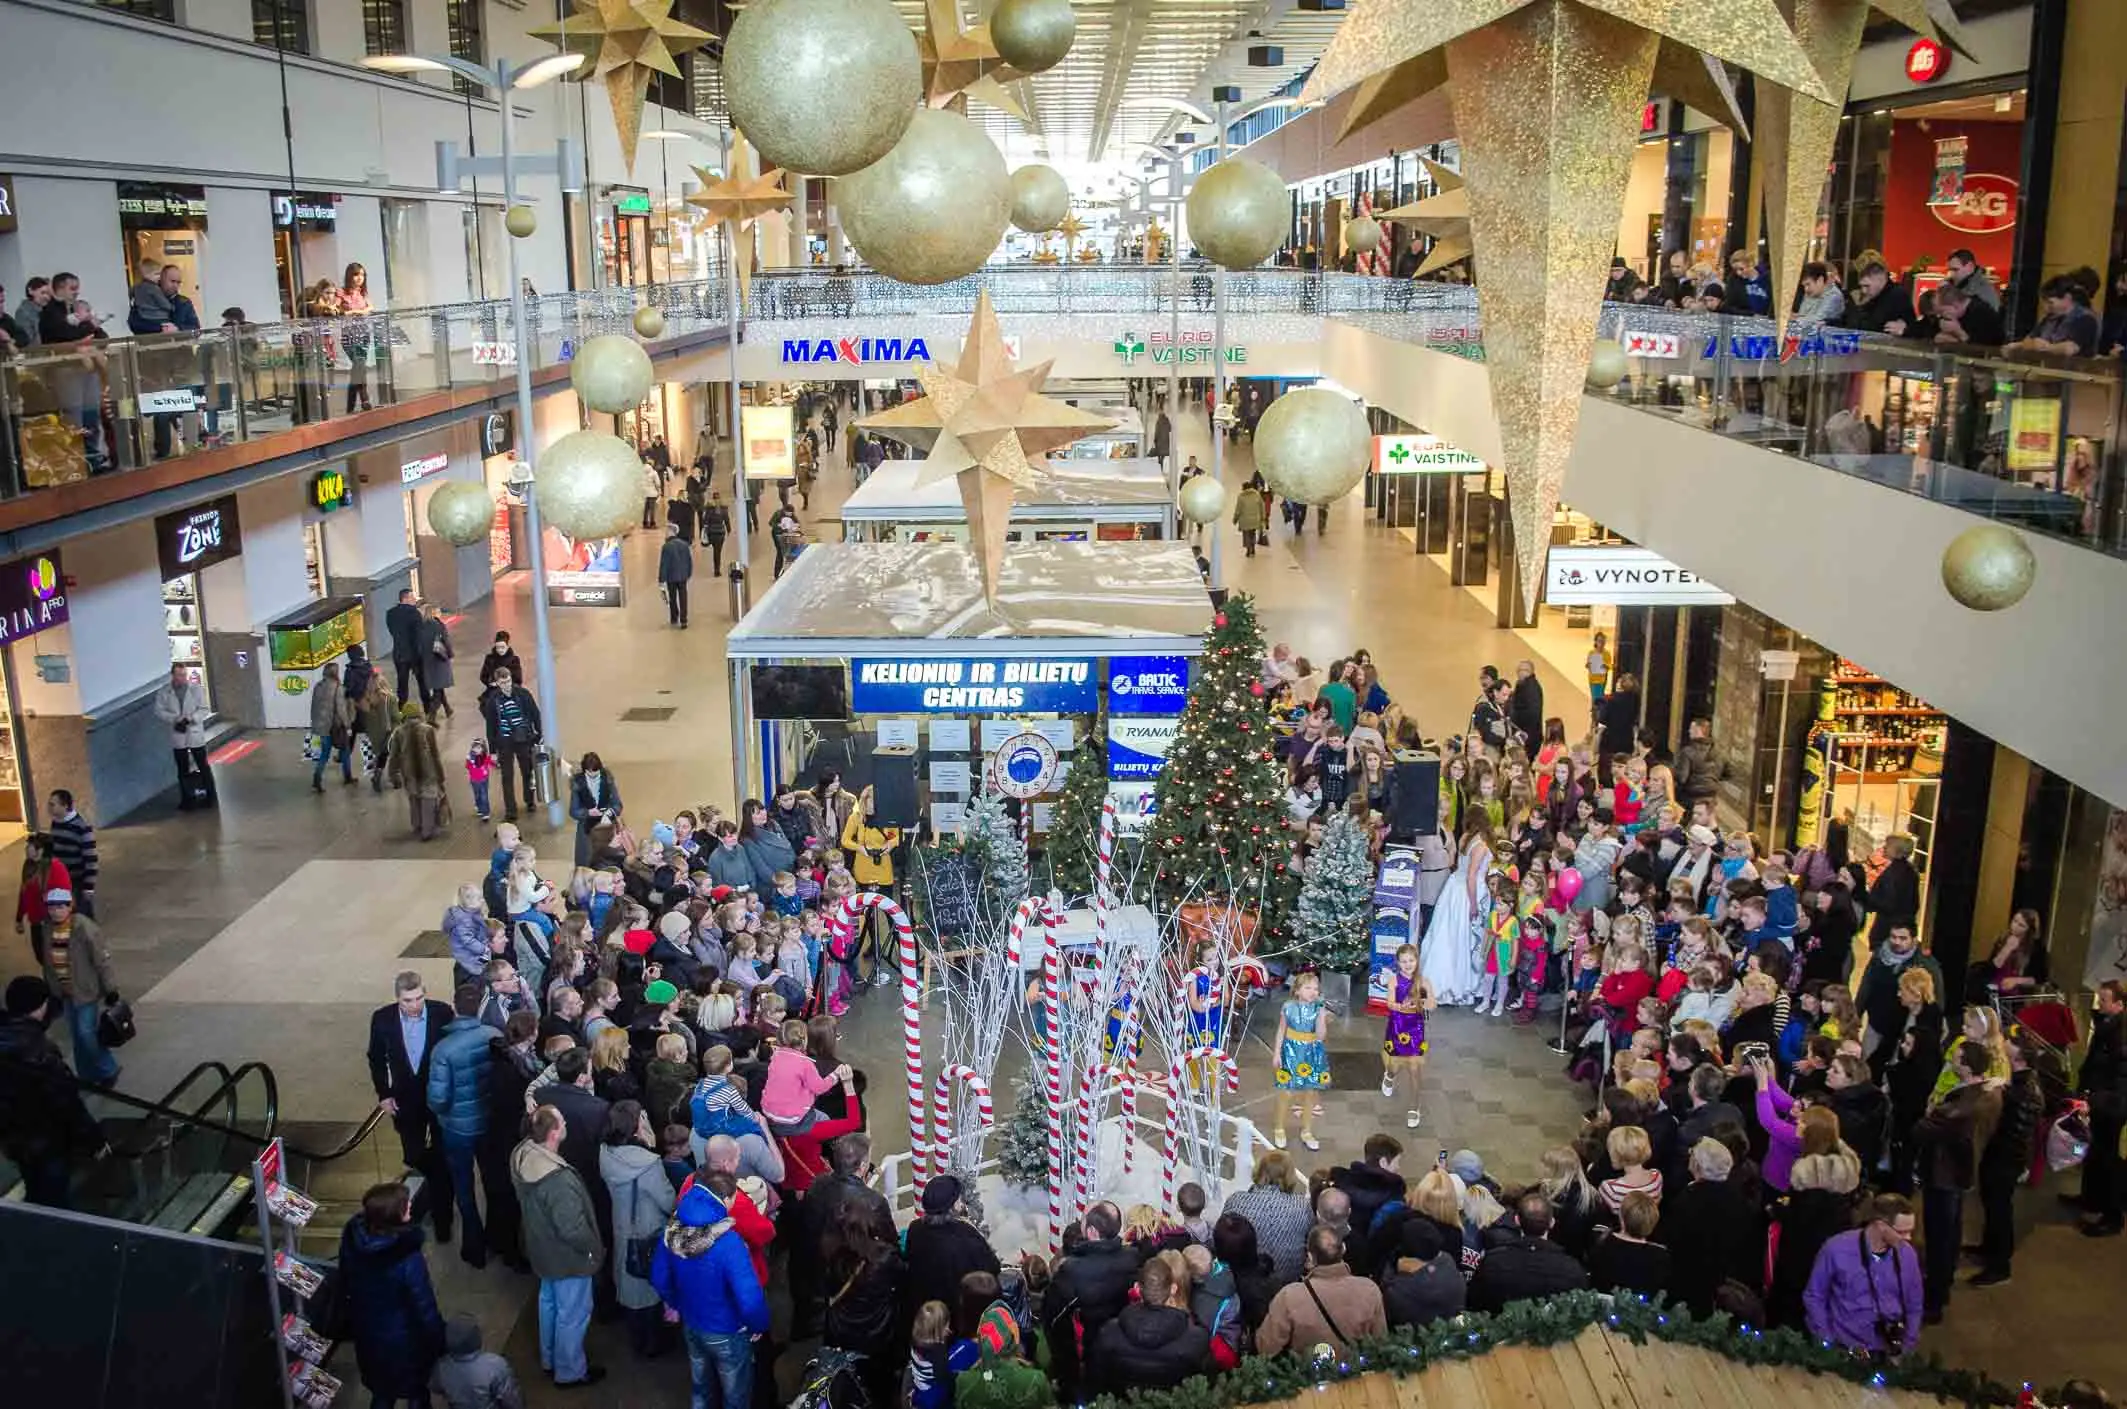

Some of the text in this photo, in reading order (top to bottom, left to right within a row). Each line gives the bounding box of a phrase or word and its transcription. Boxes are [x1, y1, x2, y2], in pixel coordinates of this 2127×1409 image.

[782, 336, 931, 366] MAXIMA
[317, 473, 345, 504] KIKA
[1595, 569, 1703, 583] VYNOTE
[861, 662, 1089, 686] KELIONIŲ IR BILIETŲ
[1138, 673, 1177, 686] BALTIC
[923, 687, 1024, 708] CENTRAS
[1131, 687, 1185, 695] TRAVEL SERVICE
[1113, 763, 1150, 773] BILIETŲ
[1328, 763, 1345, 774] VIP
